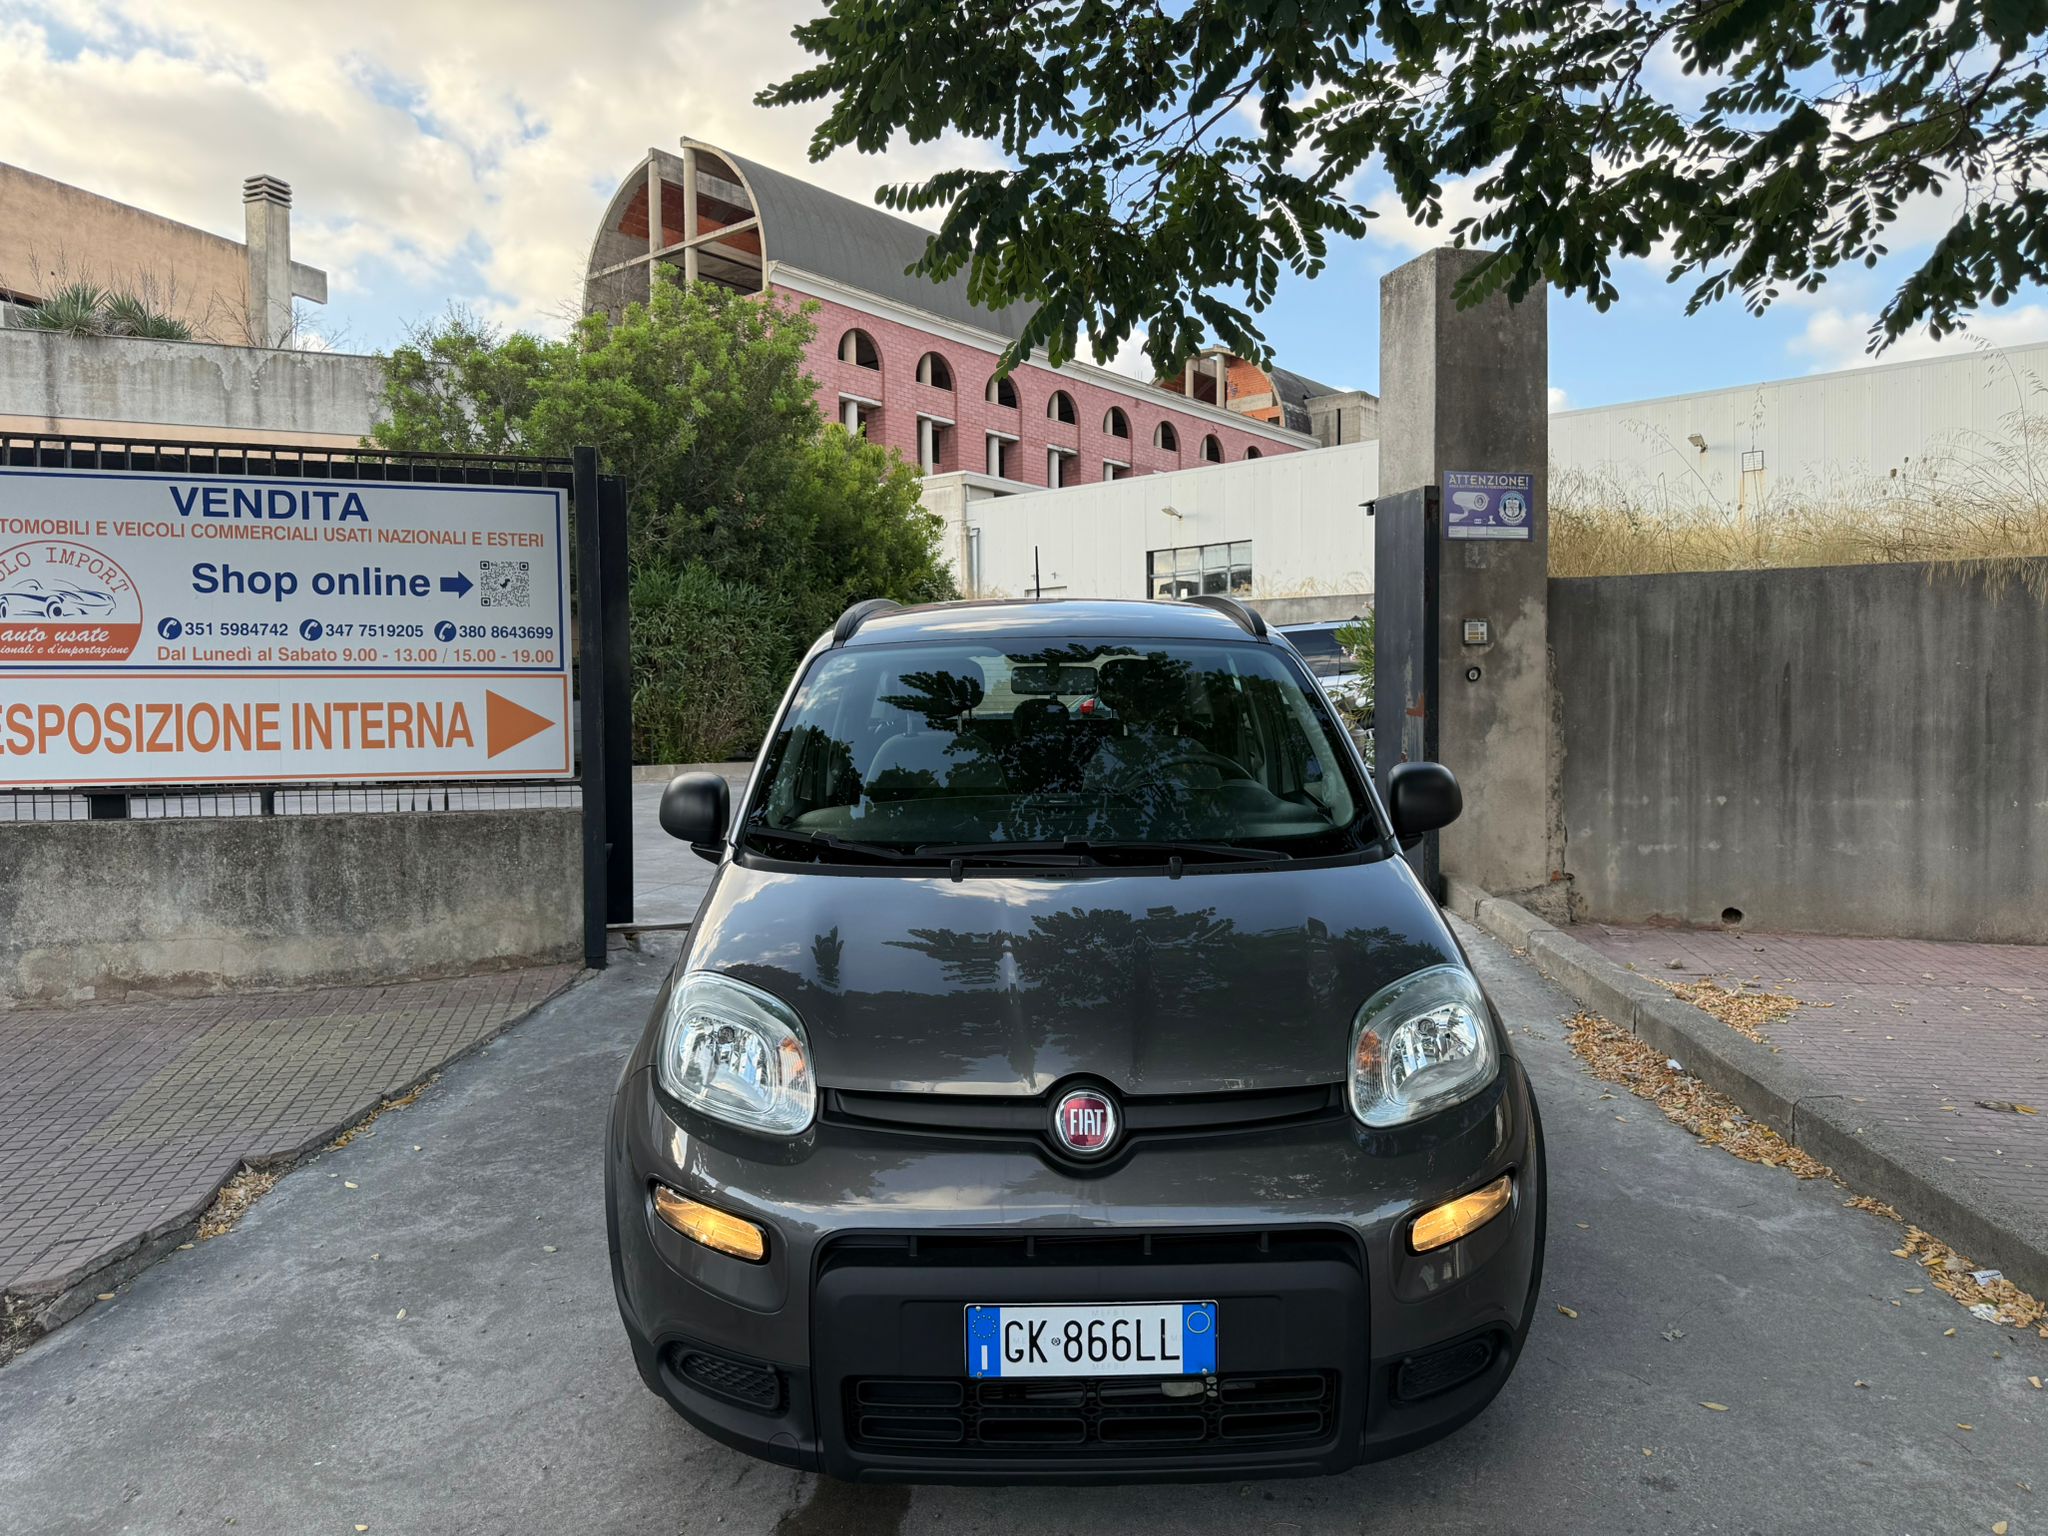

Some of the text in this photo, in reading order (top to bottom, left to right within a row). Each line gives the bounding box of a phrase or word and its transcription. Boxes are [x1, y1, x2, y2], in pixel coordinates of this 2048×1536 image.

[1449, 475, 1529, 486] ATTENZIONE!
[169, 486, 369, 522] VENDITA
[0, 518, 544, 548] TOMOBILI E VEICOLI COMMERCIALI USATI NAZIONALI E ESTERI
[46, 547, 130, 594] IMPORT
[192, 563, 431, 602] Shop online
[1, 627, 110, 642] auto usate
[185, 623, 288, 637] 351 5984742
[325, 624, 423, 638] 347 7519205
[459, 626, 554, 639] 380 8643699
[47, 643, 129, 657] d'importazione
[157, 646, 186, 661] Dal
[192, 646, 252, 662] Lunedì
[257, 648, 273, 661] al
[278, 648, 337, 662] Sabato
[343, 648, 378, 662] 9.00
[395, 648, 437, 663] 13.00
[442, 648, 448, 663] /
[454, 649, 496, 663] 15.00
[513, 649, 554, 663] 19.00
[292, 702, 474, 750] INTERNA
[1070, 1109, 1104, 1136] FIAT
